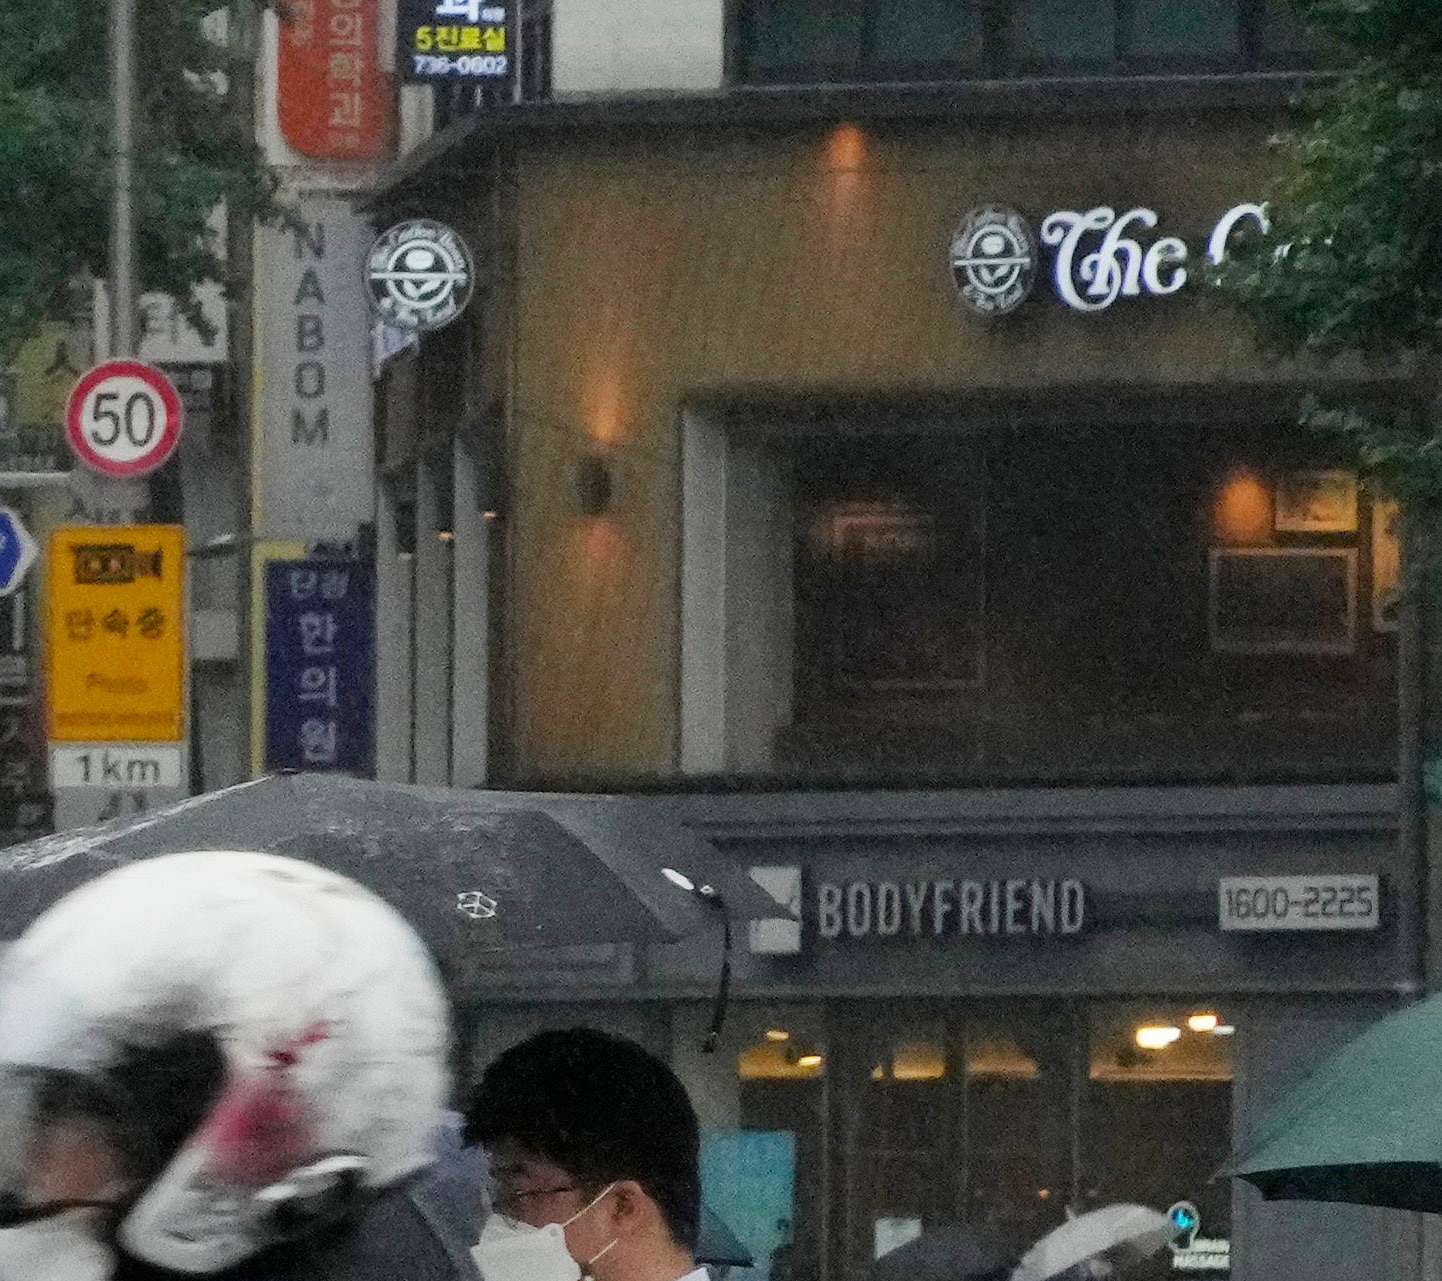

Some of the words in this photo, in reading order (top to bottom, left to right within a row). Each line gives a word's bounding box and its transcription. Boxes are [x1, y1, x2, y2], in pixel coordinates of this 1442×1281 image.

[327, 0, 364, 127] 의학과
[1041, 206, 1188, 312] The
[291, 221, 330, 445] NABOM
[91, 391, 155, 447] 50
[297, 611, 338, 762] 한의원
[817, 878, 1086, 937] BODYFRIEND
[1226, 885, 1375, 919] 1600-2225
